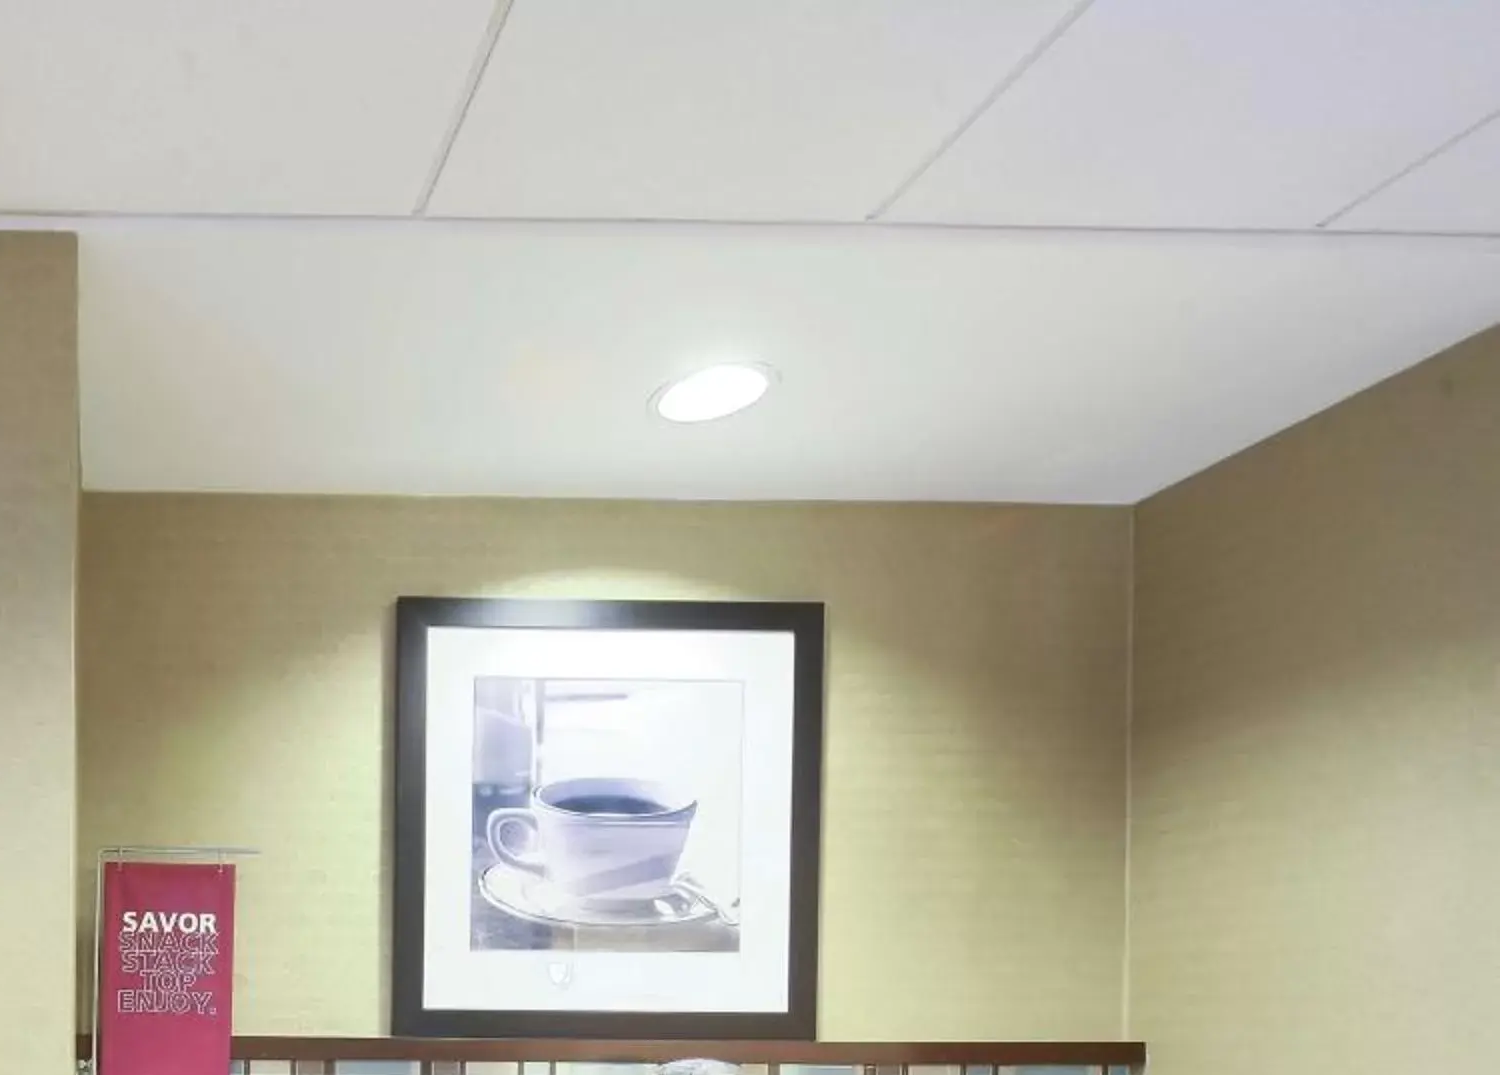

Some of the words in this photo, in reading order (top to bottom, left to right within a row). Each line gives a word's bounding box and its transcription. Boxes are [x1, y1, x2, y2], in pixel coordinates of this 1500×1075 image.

[122, 911, 217, 933] SAVOR
[119, 931, 220, 954] SNACK
[121, 950, 216, 975] STACK
[139, 970, 197, 993] TOP
[117, 989, 217, 1015] ENJOY.
